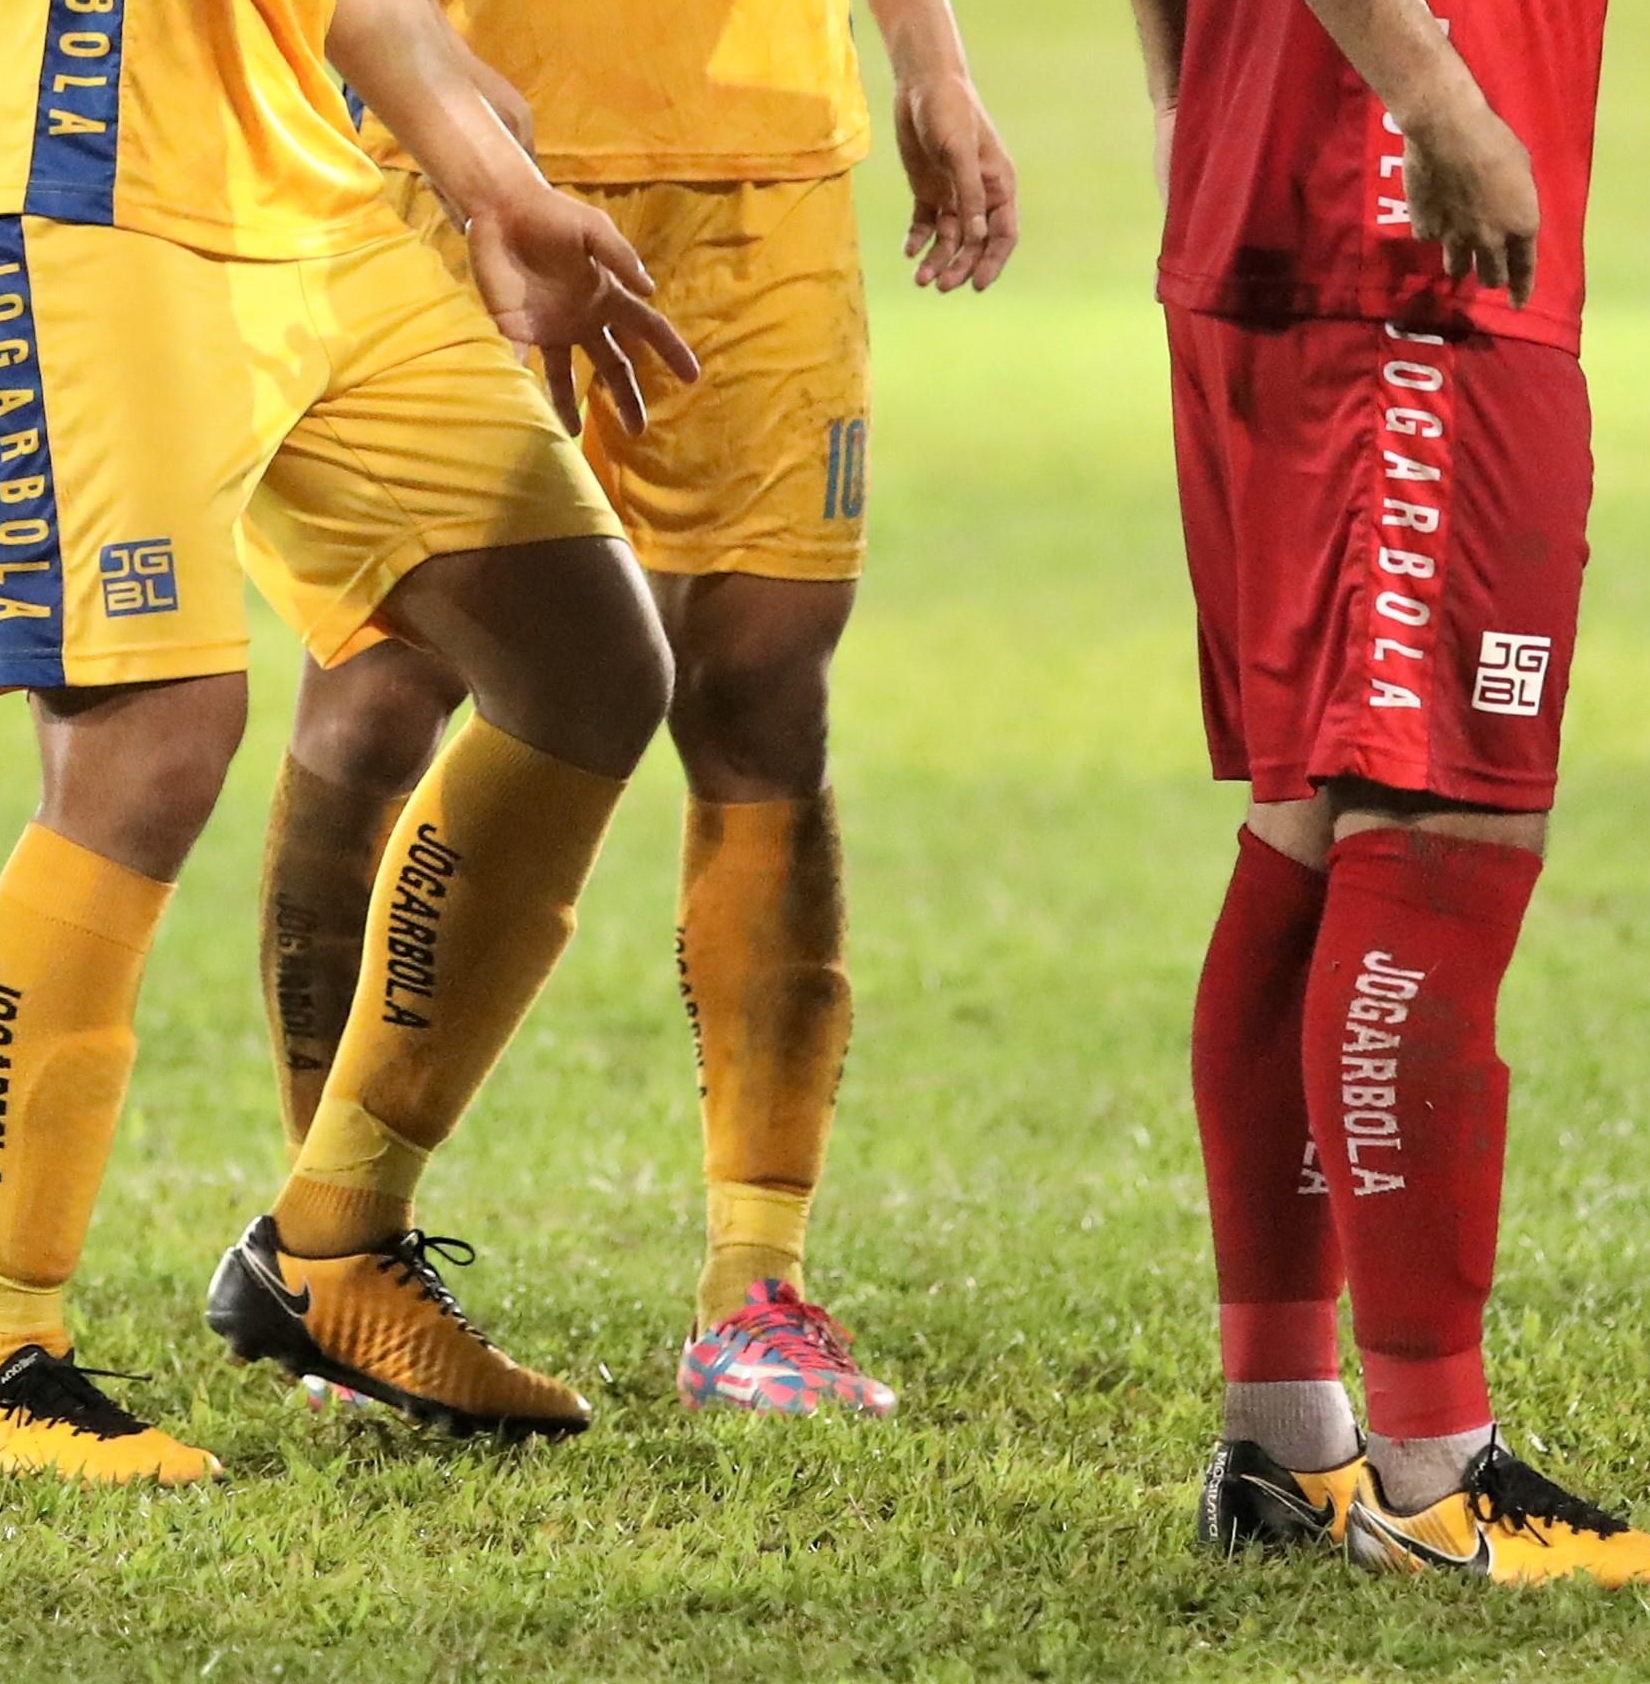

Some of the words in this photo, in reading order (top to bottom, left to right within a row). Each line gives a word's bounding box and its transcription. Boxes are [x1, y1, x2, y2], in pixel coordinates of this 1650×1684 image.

[824, 419, 864, 518] 10
[1372, 322, 1444, 710] JOGARBOLA
[382, 822, 463, 1030] JOGARBOLA
[1341, 949, 1427, 1197] JOGARBOLA
